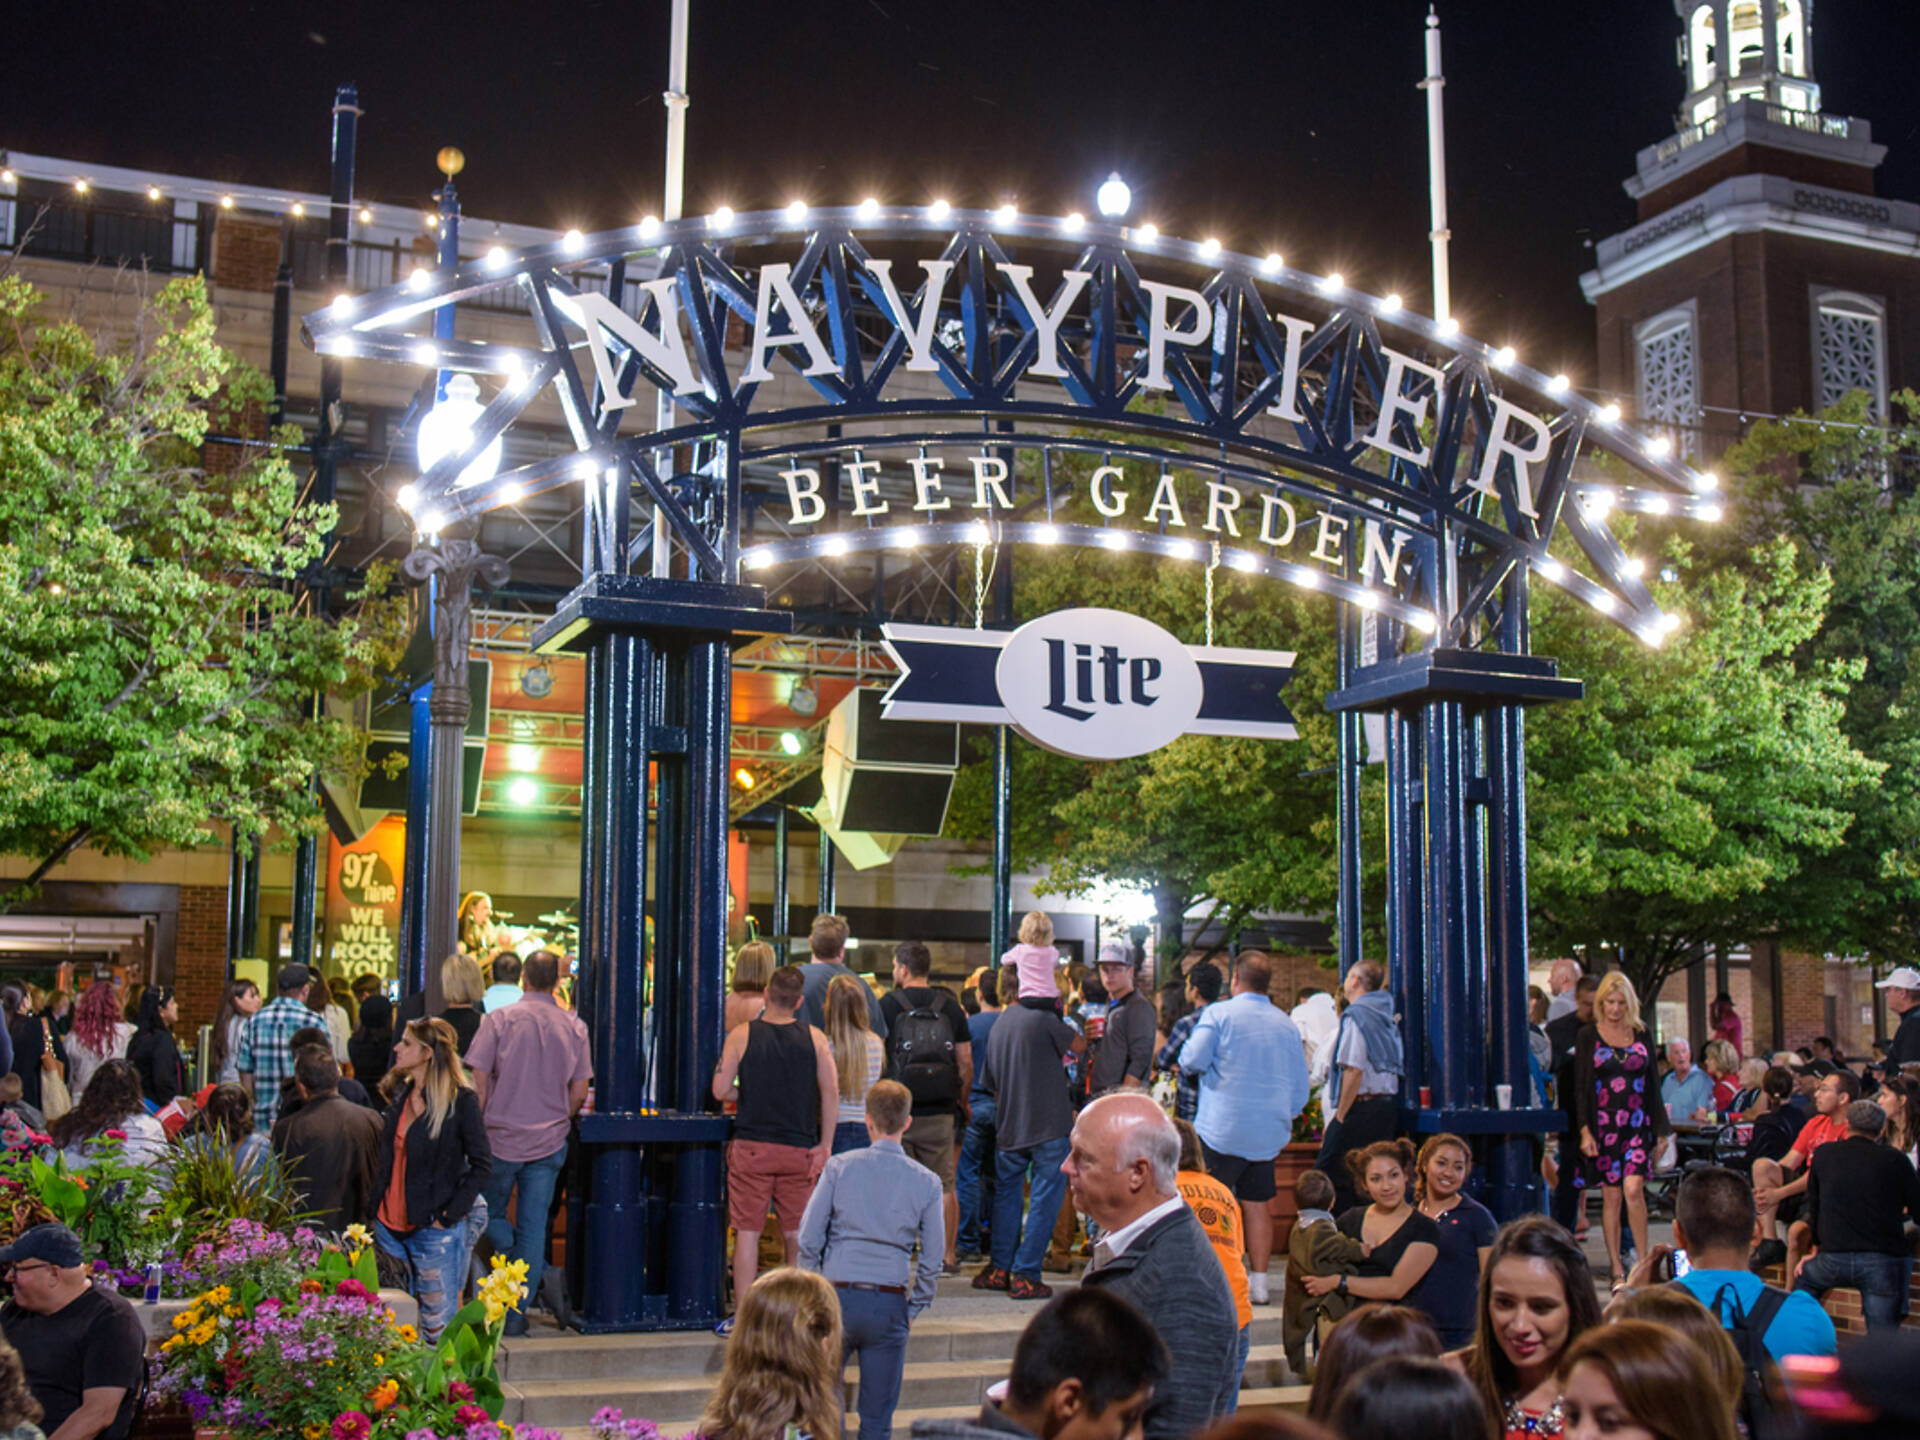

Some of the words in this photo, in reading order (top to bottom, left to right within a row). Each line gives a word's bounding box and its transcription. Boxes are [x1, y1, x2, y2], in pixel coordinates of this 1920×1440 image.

[578, 259, 1092, 411] NAVY
[1135, 279, 1551, 519] PIER
[779, 456, 1015, 525] BEER
[1090, 465, 1409, 587] GARDEN
[1041, 638, 1162, 722] Lite
[364, 880, 396, 903] nine
[351, 907, 384, 925] WE
[341, 924, 391, 943] WILL
[334, 942, 394, 962] ROCK
[341, 960, 388, 980] YOU
